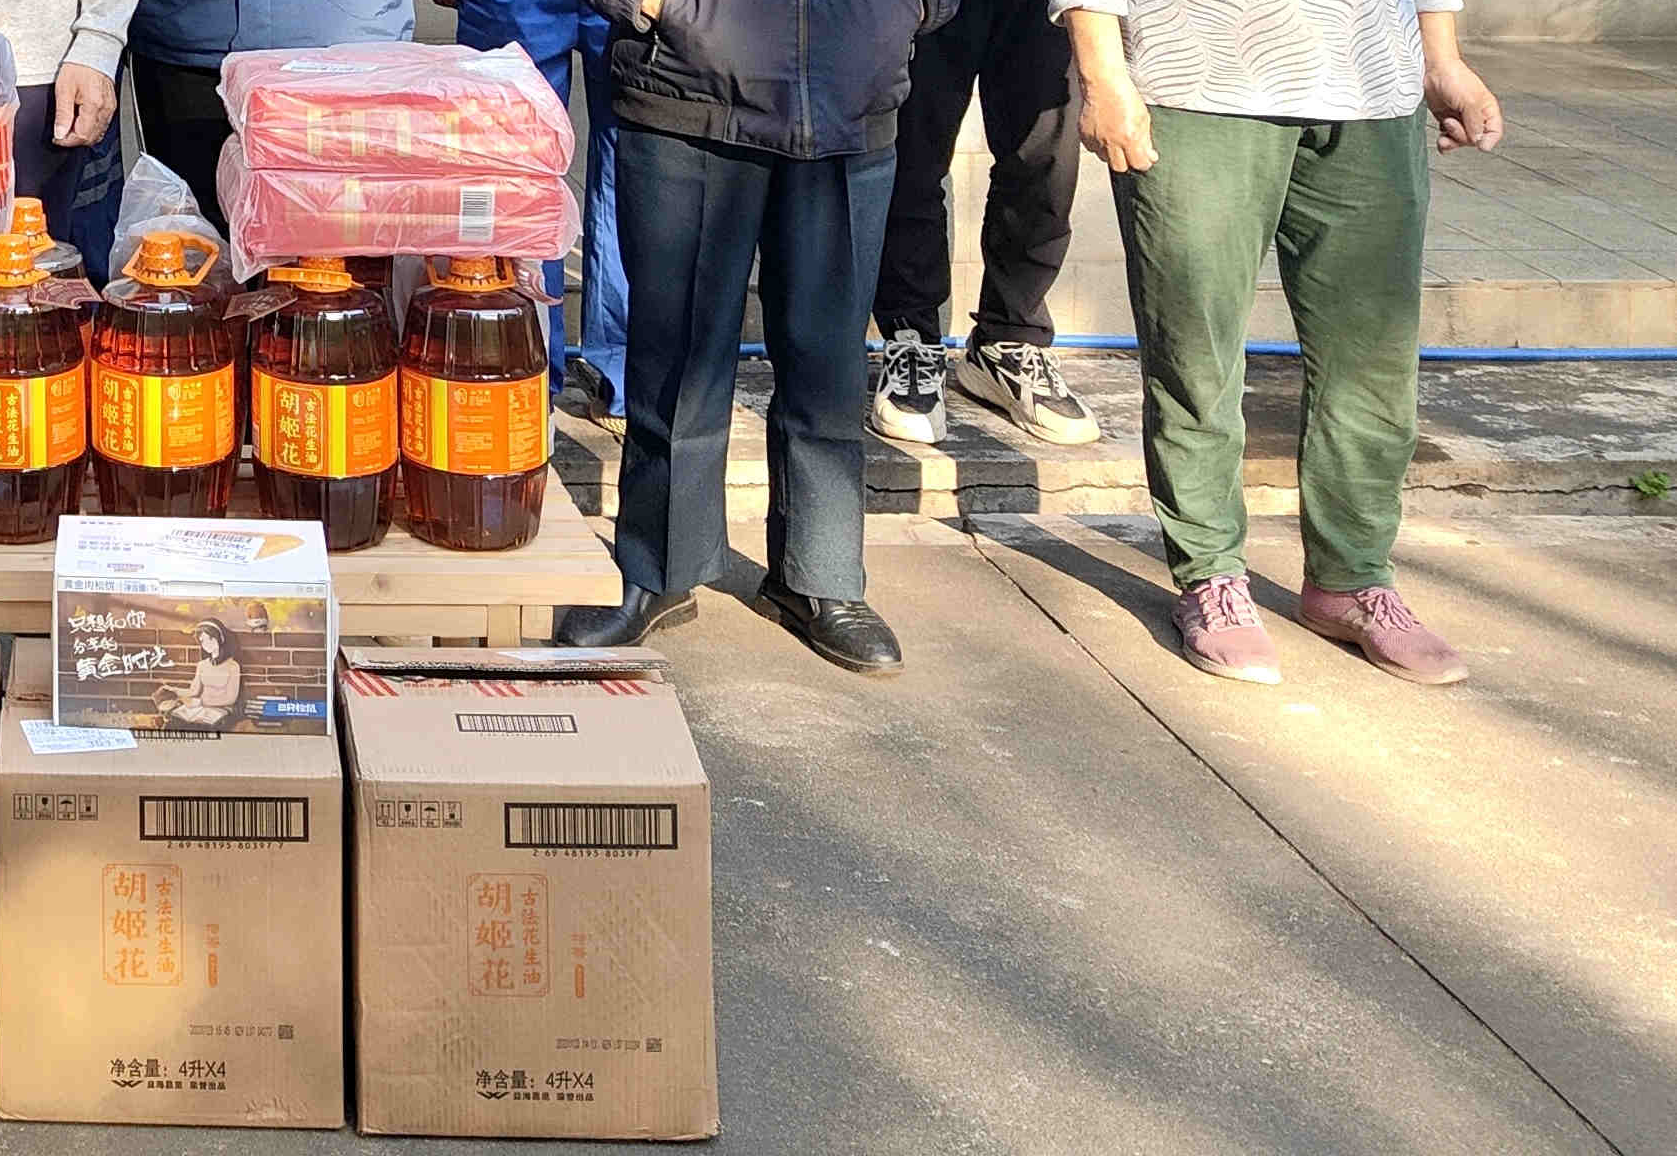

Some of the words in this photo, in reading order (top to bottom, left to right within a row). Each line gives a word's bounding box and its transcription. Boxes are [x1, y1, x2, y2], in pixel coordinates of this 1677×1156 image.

[6, 393, 19, 458] 古法花生油
[103, 377, 120, 452] 胡姬花
[279, 391, 302, 465] 胡姬花
[305, 397, 318, 463] 古法花生油
[67, 609, 146, 634] 只想和你
[73, 636, 118, 655] 分享的
[76, 644, 175, 681] 黄金时光
[113, 871, 148, 979] 胡姬花
[155, 877, 175, 973] 古法花生油
[475, 882, 515, 990] 胡姬花
[521, 888, 541, 985] 古法花生油
